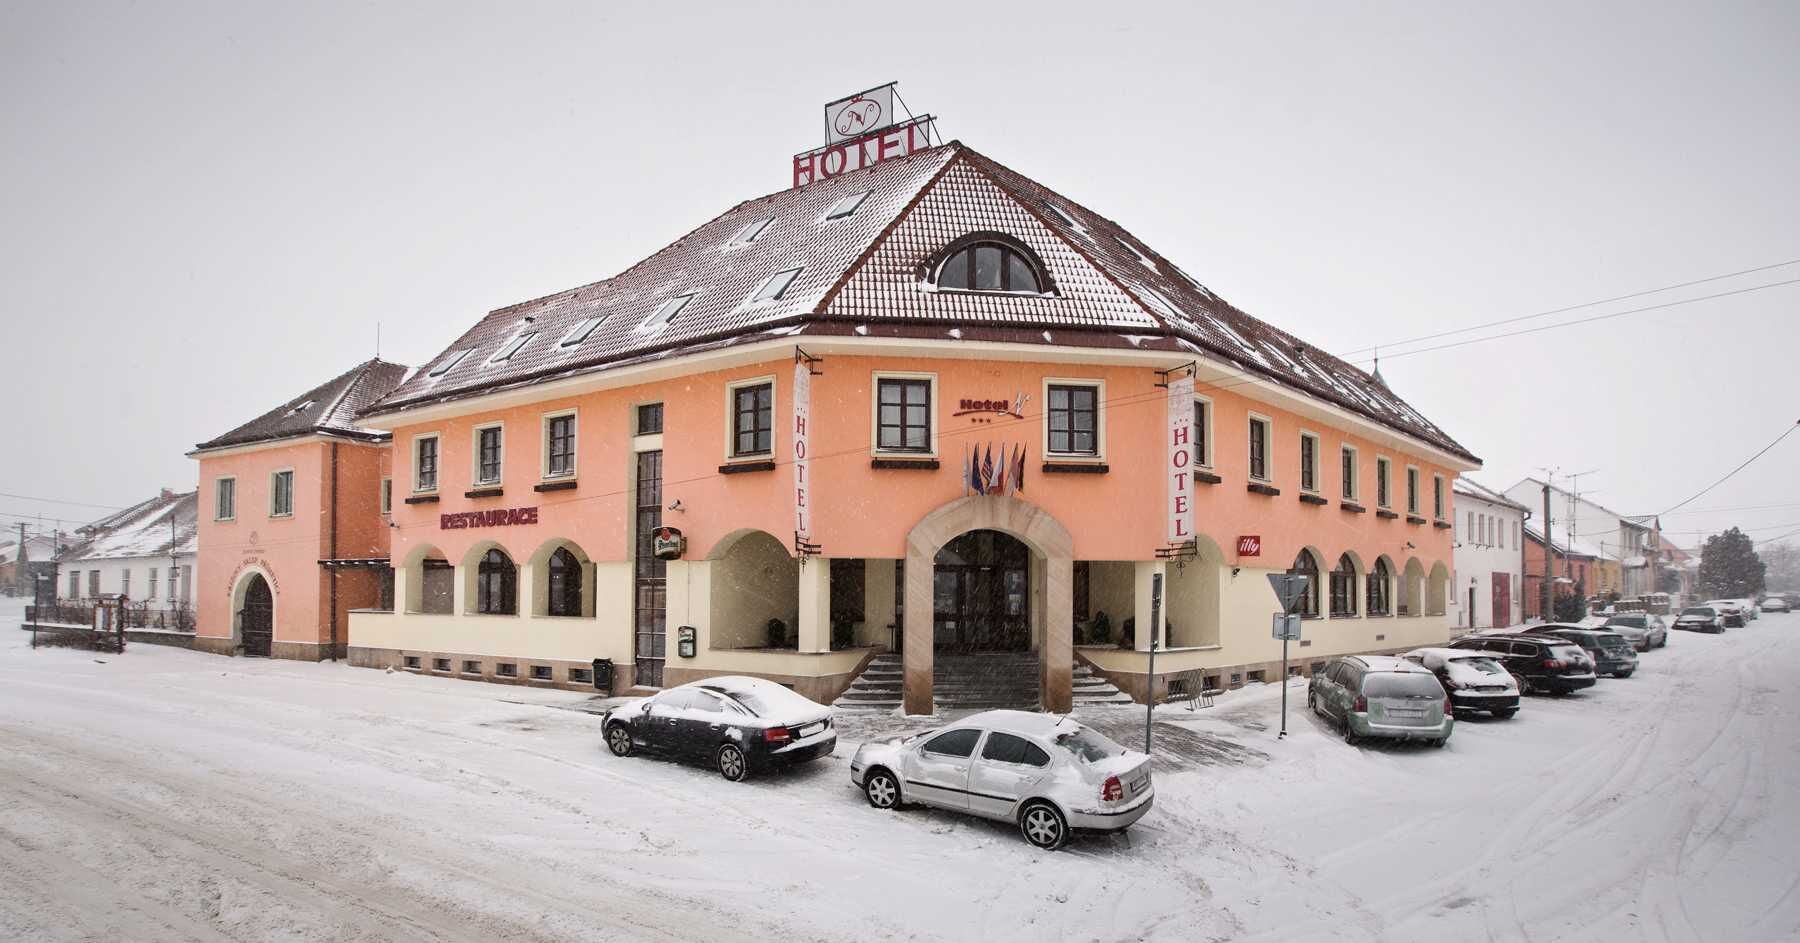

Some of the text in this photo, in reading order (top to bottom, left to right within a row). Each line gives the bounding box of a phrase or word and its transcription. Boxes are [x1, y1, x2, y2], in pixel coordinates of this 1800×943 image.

[793, 122, 929, 191] HOTEL
[960, 399, 1009, 410] Hotel
[795, 415, 806, 531] HOTEL
[1173, 427, 1188, 536] HOTEL
[440, 506, 538, 530] RESTAURACE
[1240, 538, 1260, 555] illy
